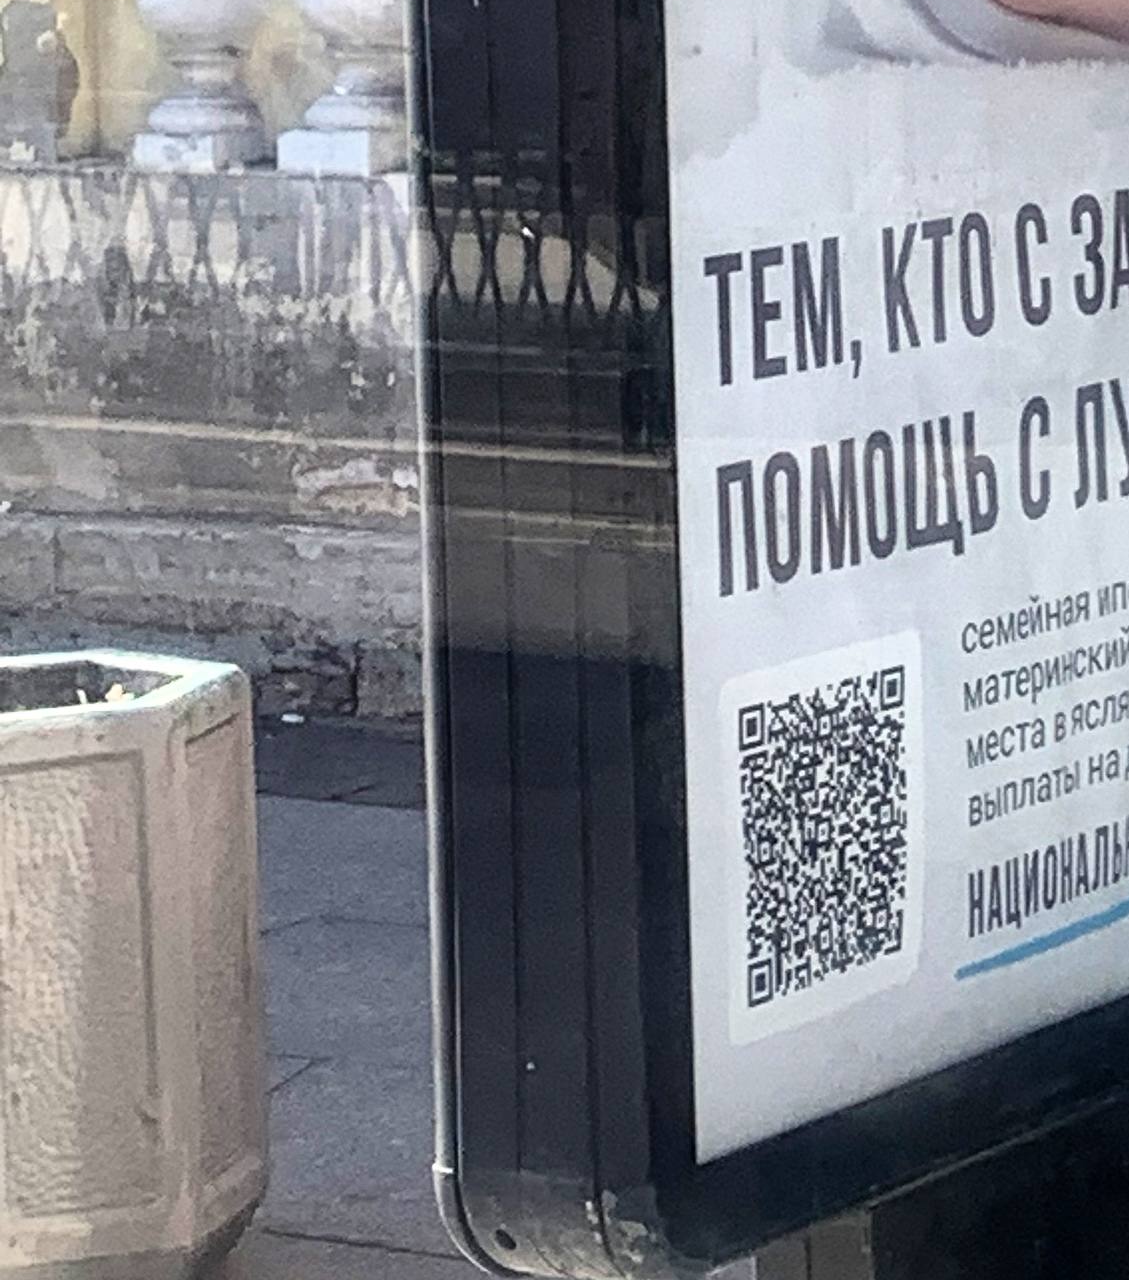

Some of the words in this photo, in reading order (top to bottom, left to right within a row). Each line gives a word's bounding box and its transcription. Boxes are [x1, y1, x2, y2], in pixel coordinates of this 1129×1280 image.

[703, 235, 863, 387] ТЕМ,
[882, 211, 997, 354] КТО
[1014, 202, 1052, 327] С
[715, 409, 999, 598] ПОМОЩЬ
[1018, 395, 1052, 521] С
[961, 590, 1091, 655] семейная
[966, 717, 1046, 769] места
[1053, 710, 1066, 743] в
[968, 761, 1081, 828] выплаты
[1087, 752, 1121, 786] на
